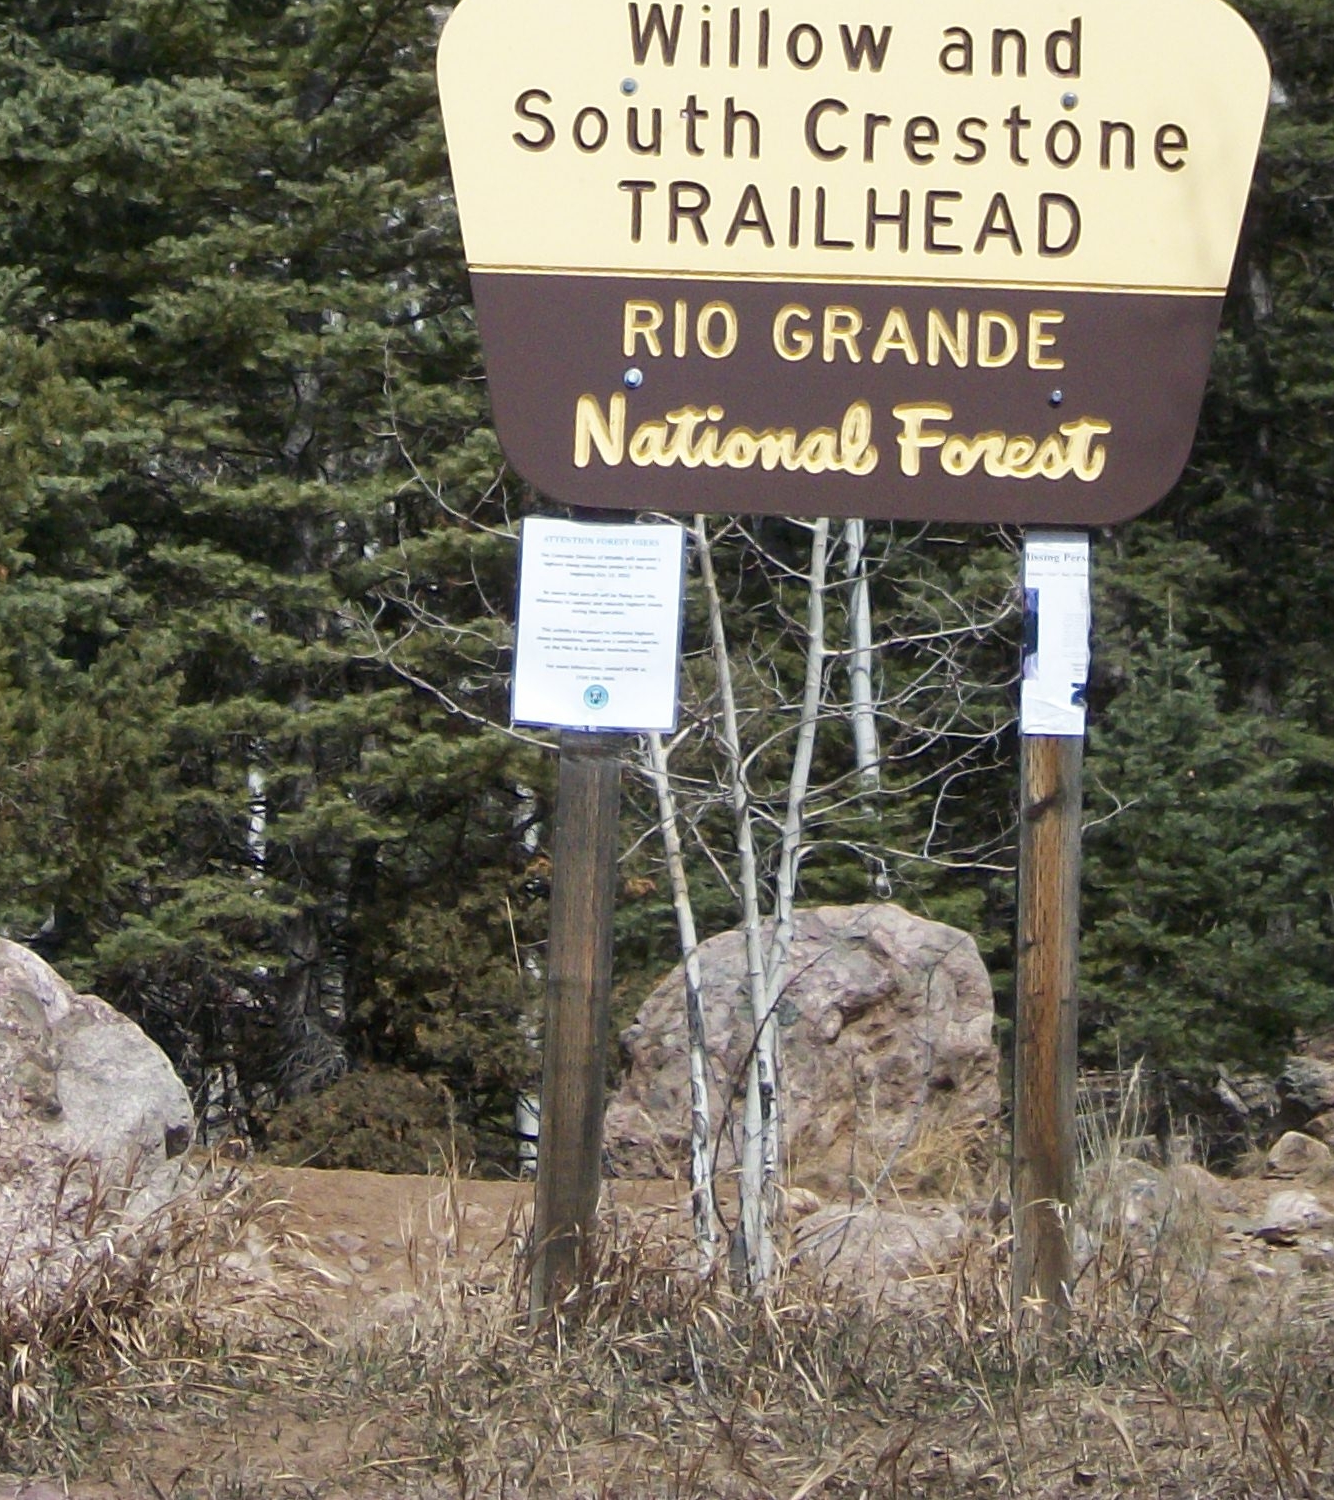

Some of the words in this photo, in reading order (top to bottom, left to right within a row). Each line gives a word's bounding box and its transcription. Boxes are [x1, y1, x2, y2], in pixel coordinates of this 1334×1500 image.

[628, 2, 893, 72] Willow
[938, 16, 1083, 79] and
[512, 88, 761, 159] South
[804, 98, 1189, 172] Crestone
[618, 180, 1082, 256] TRAILHEAD
[622, 300, 737, 359] RIO
[773, 305, 1065, 370] GRANDE
[574, 391, 878, 476] National
[892, 401, 1112, 481] Forest
[544, 536, 594, 545] ATTENTION
[596, 538, 630, 546] FOREST
[1064, 553, 1088, 563] Pers
